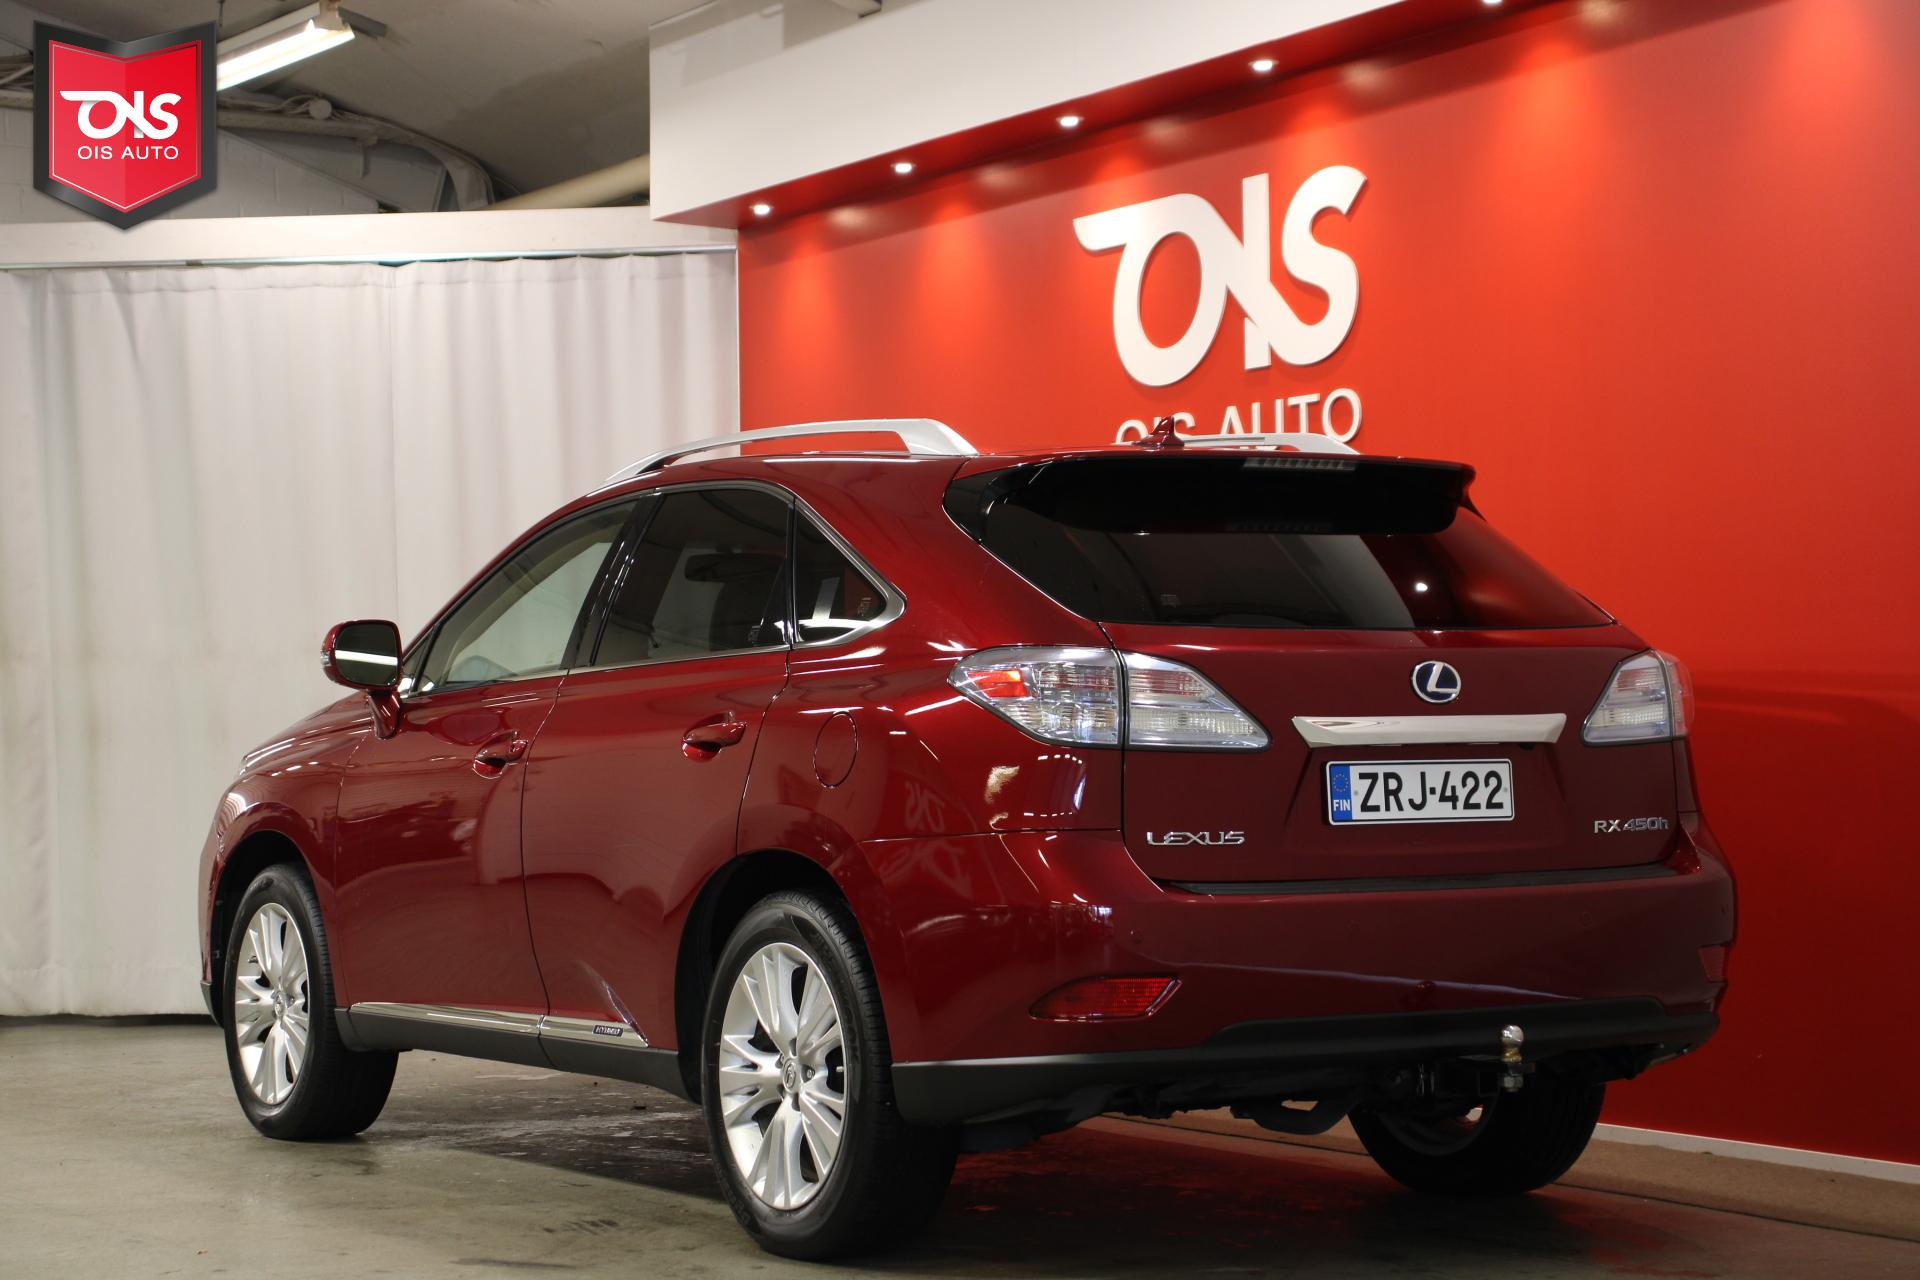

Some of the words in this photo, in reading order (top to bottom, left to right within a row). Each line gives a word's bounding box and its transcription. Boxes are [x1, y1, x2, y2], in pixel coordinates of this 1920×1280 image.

[1221, 388, 1362, 450] AUTO
[1358, 770, 1504, 812] ZRJ-422
[1333, 799, 1351, 812] FIN
[1594, 819, 1621, 833] RX
[1623, 817, 1669, 831] 450h
[1146, 831, 1245, 845] LEXUS
